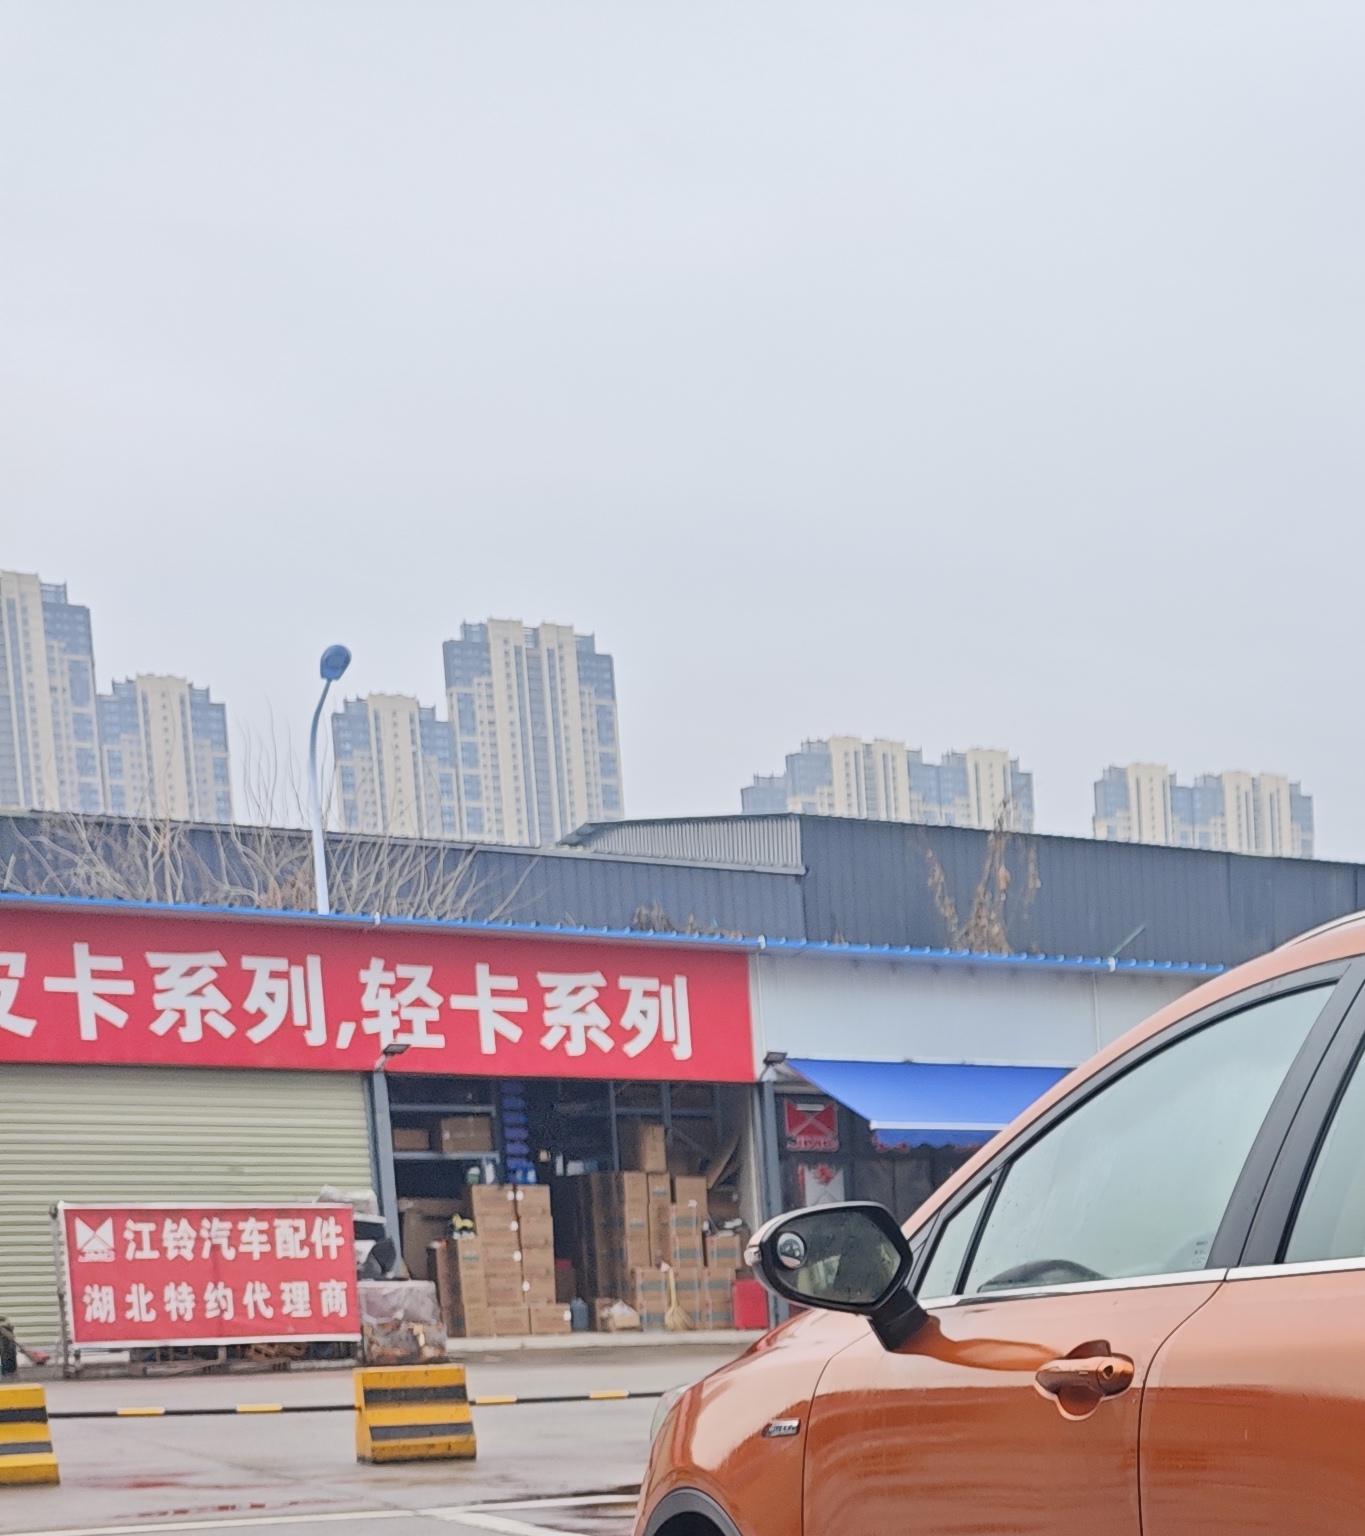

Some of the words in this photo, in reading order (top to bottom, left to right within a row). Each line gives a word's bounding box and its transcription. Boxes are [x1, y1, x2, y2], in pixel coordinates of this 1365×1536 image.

[123, 1216, 345, 1262] 江铃汽车配件
[83, 1280, 348, 1323] 湖北特约代理商
